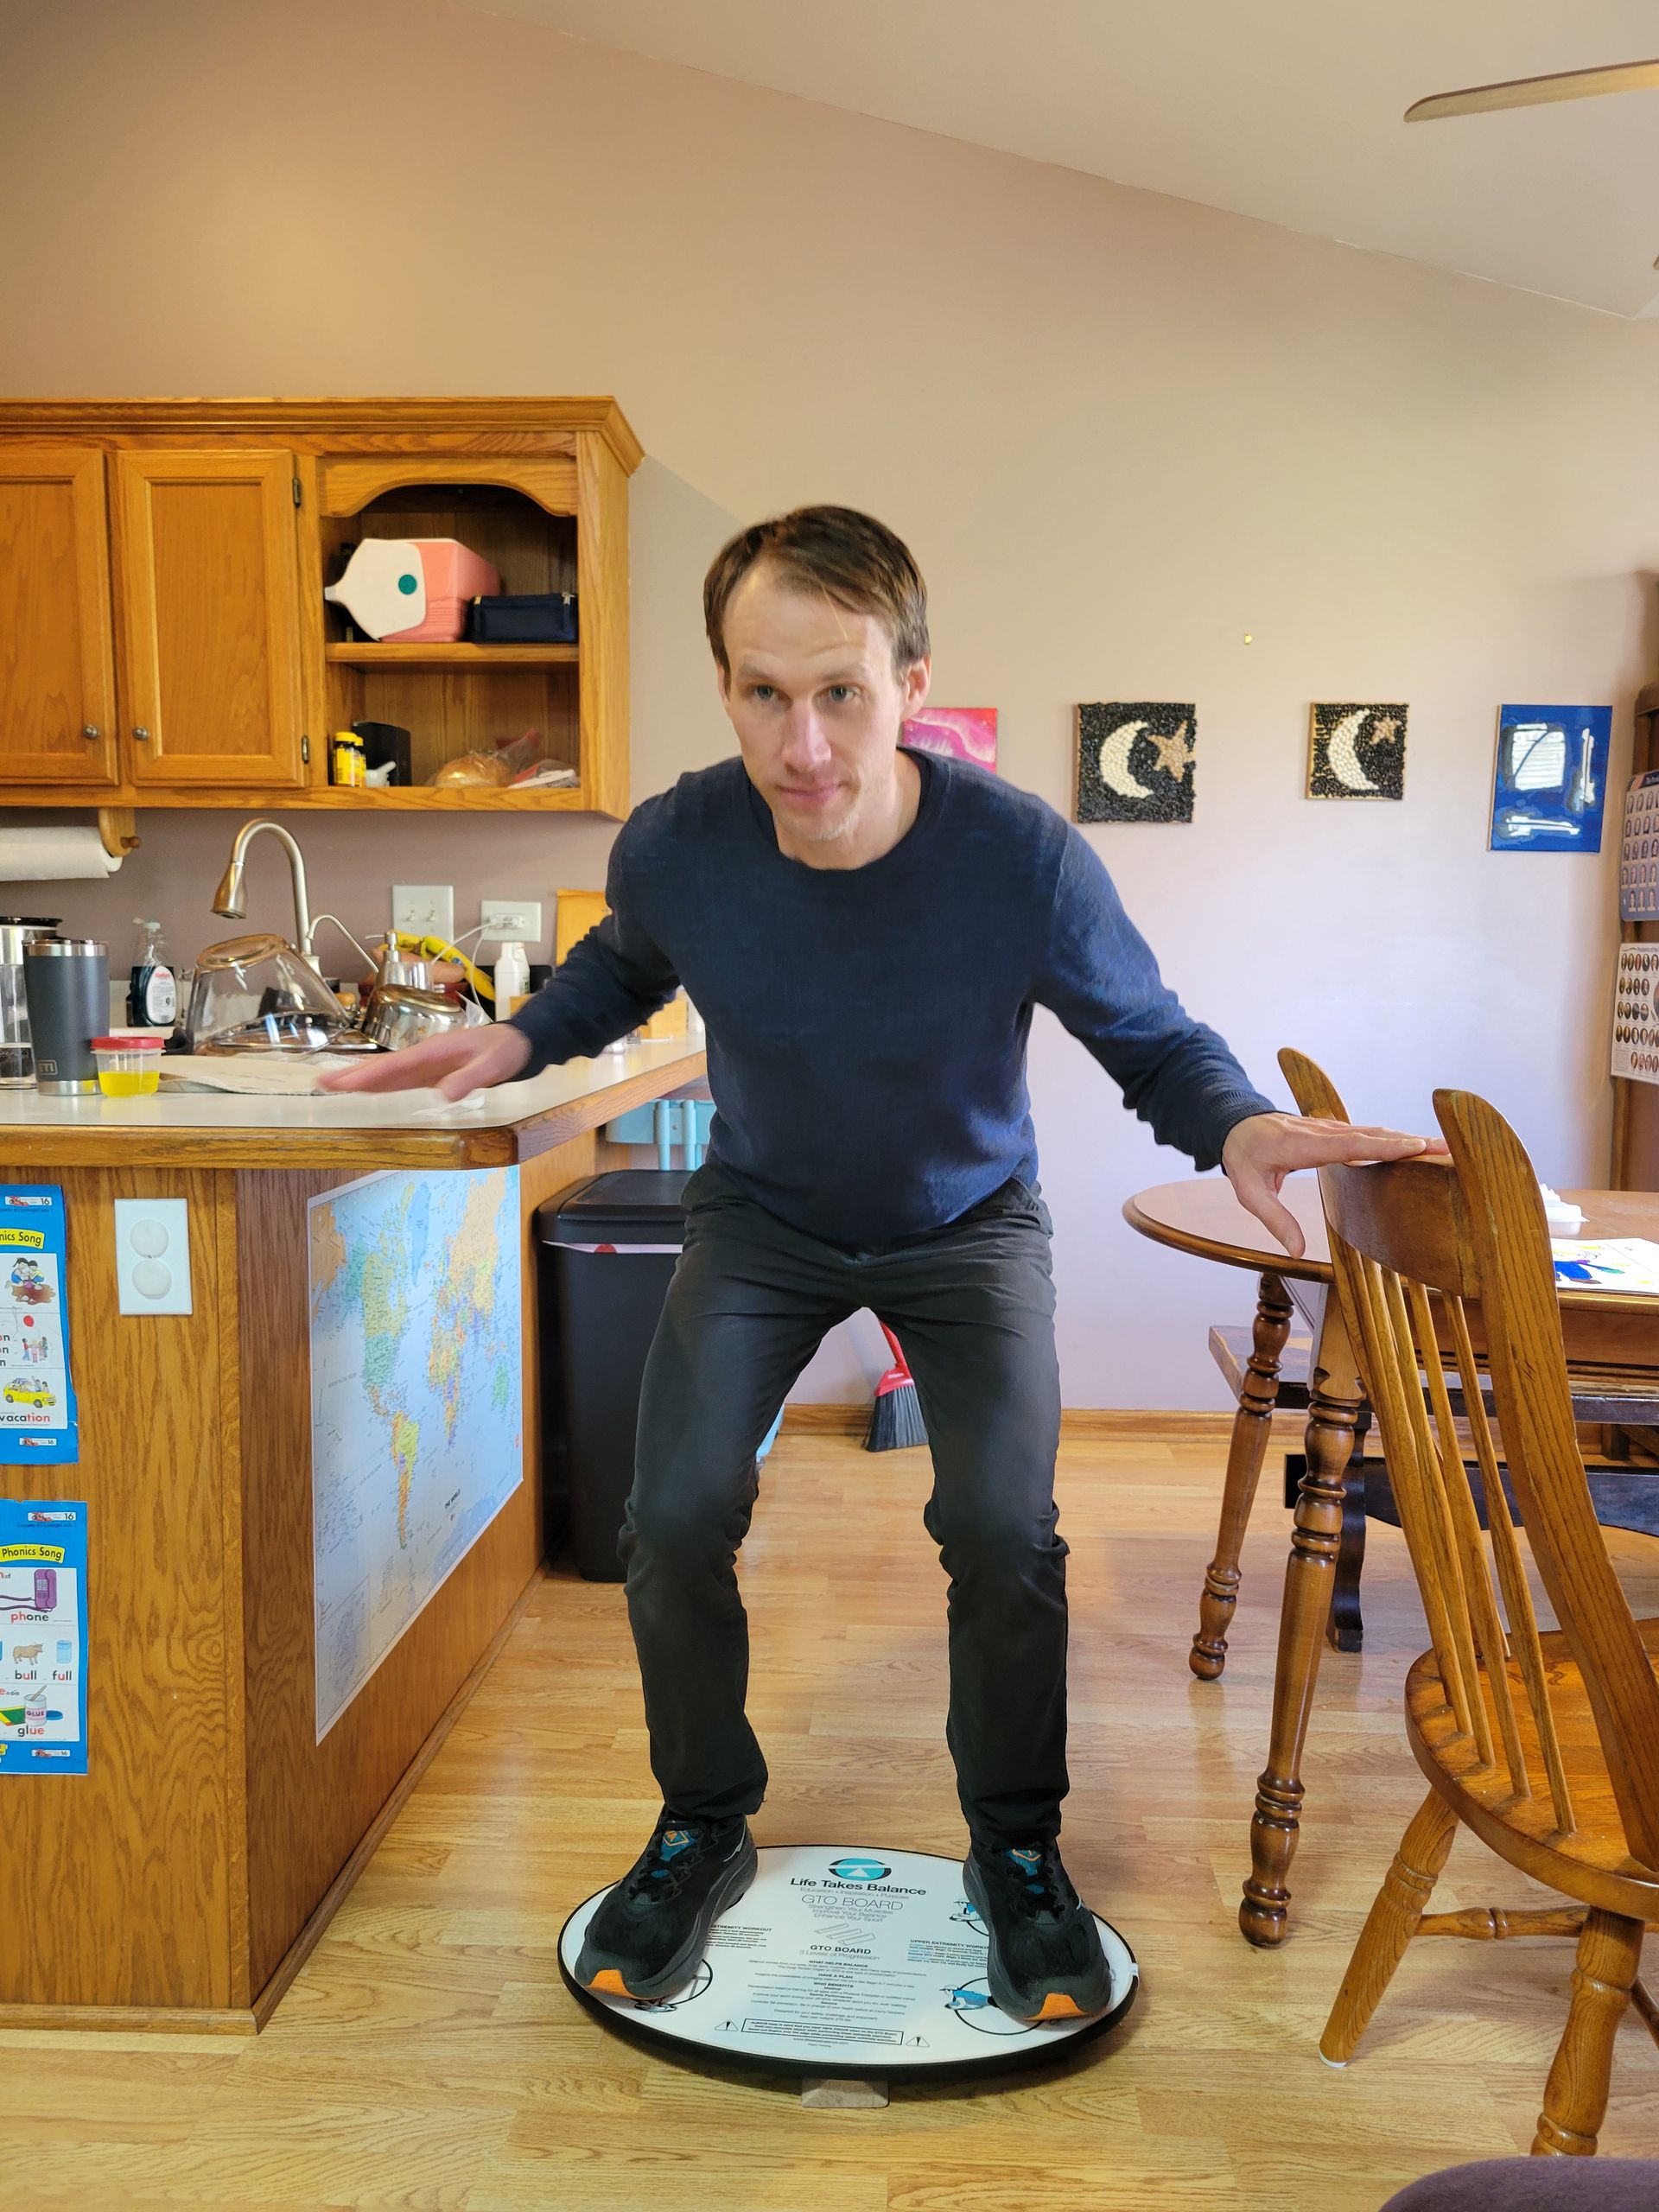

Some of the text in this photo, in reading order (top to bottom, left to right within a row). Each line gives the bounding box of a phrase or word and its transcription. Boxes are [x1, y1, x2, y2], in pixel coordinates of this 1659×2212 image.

[18, 1231, 41, 1247] Song
[0, 1412, 50, 1422] vacation
[64, 1512, 74, 1521] 16
[2, 1546, 62, 1561] Phonics Song
[10, 1611, 49, 1624] phone
[15, 1669, 73, 1681] bull full
[17, 1725, 45, 1738] glue
[790, 1878, 927, 1896] Life Takes Balance
[801, 1894, 904, 1910] GTO BOARD
[834, 1946, 872, 1955] BOARD
